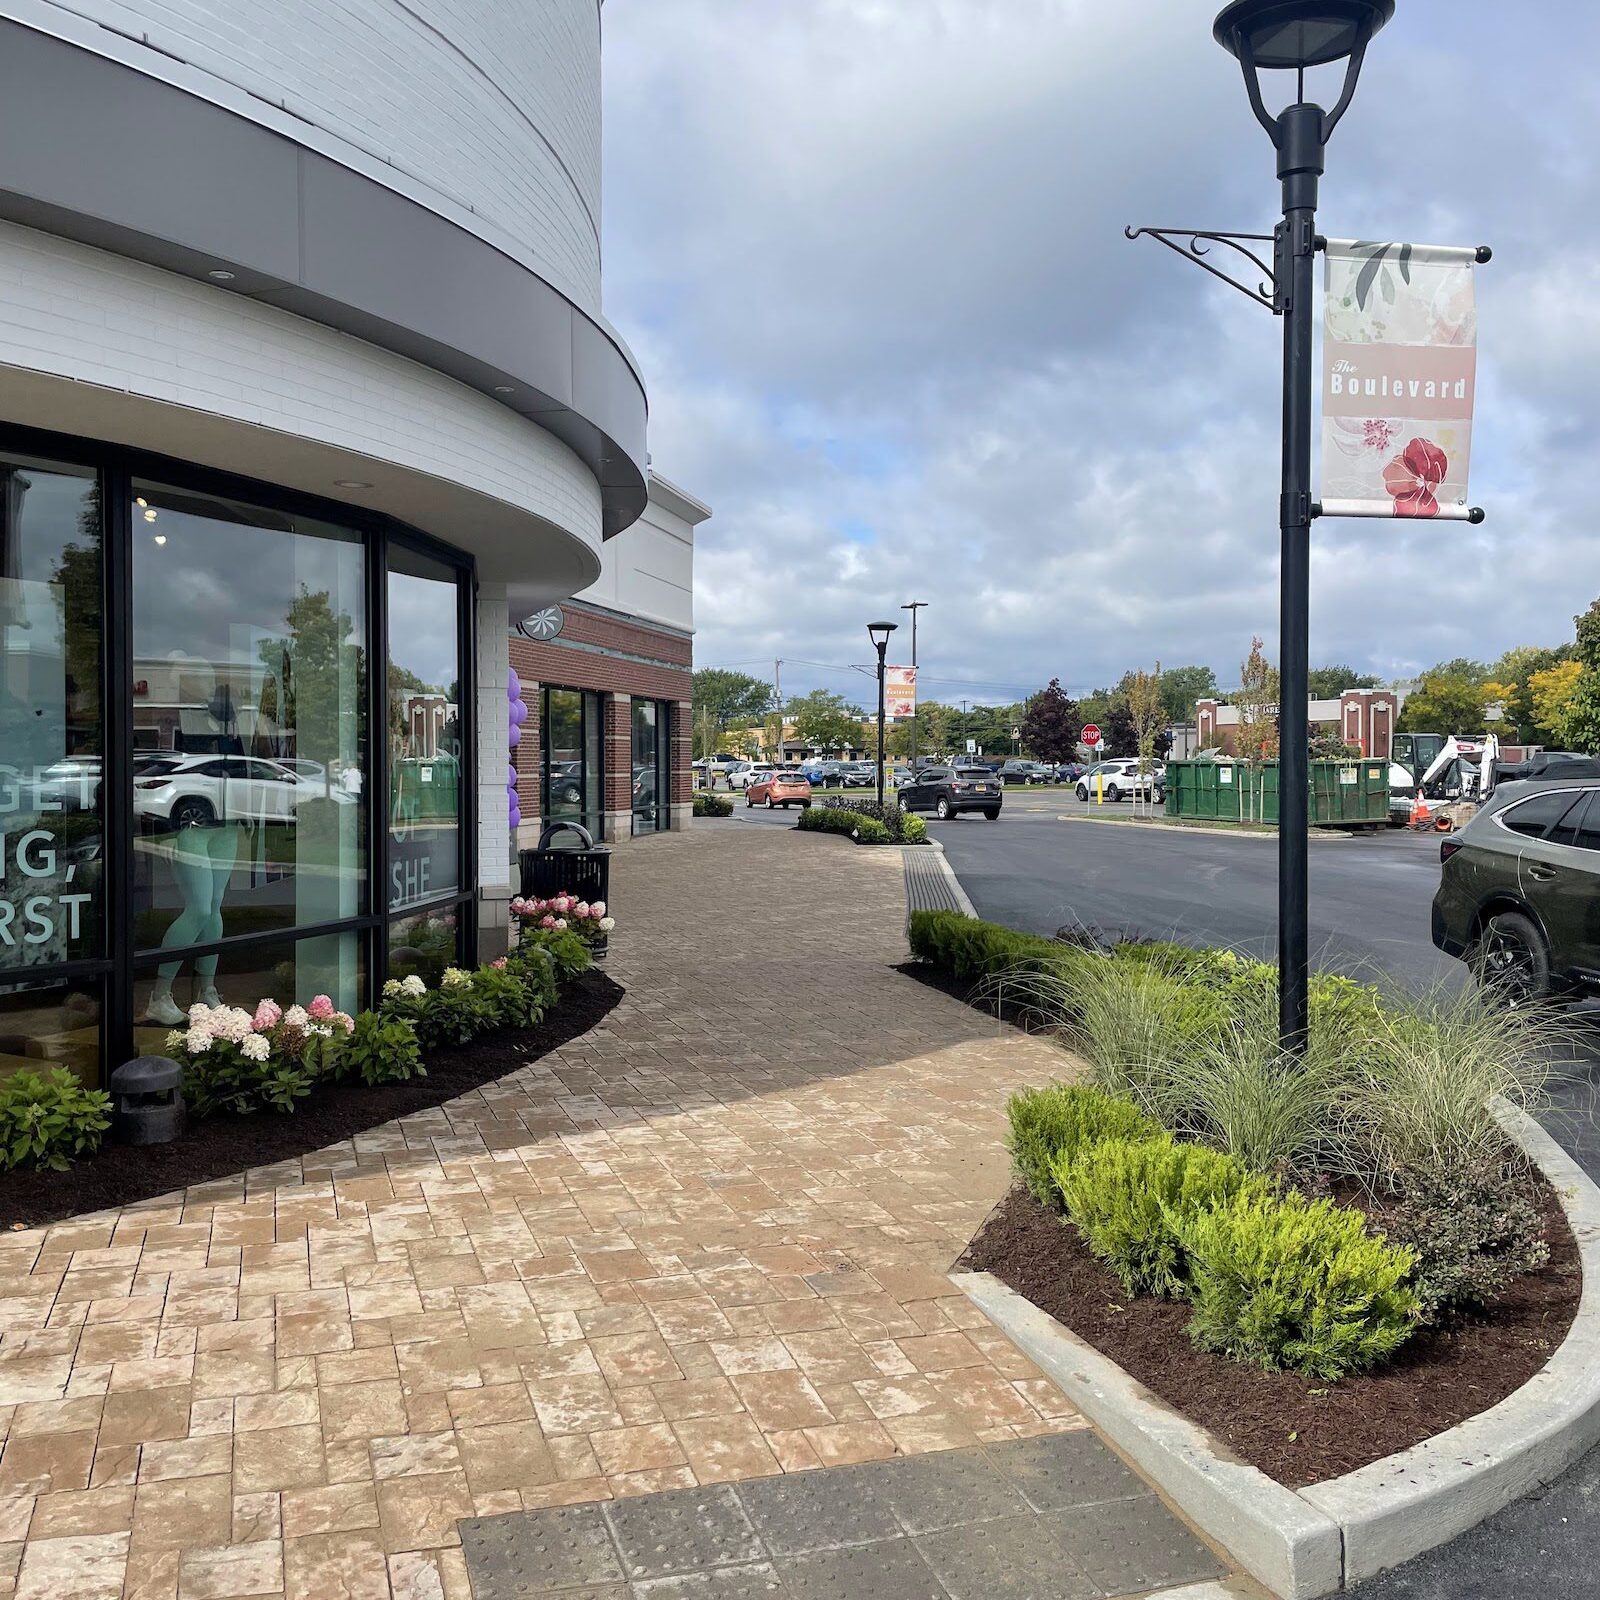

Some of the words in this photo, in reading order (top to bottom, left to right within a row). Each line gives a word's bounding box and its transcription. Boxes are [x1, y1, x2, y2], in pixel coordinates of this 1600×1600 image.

[1331, 359, 1359, 373] The
[1331, 374, 1466, 399] Boulevard
[1083, 731, 1100, 740] STOP
[392, 857, 431, 907] SHE
